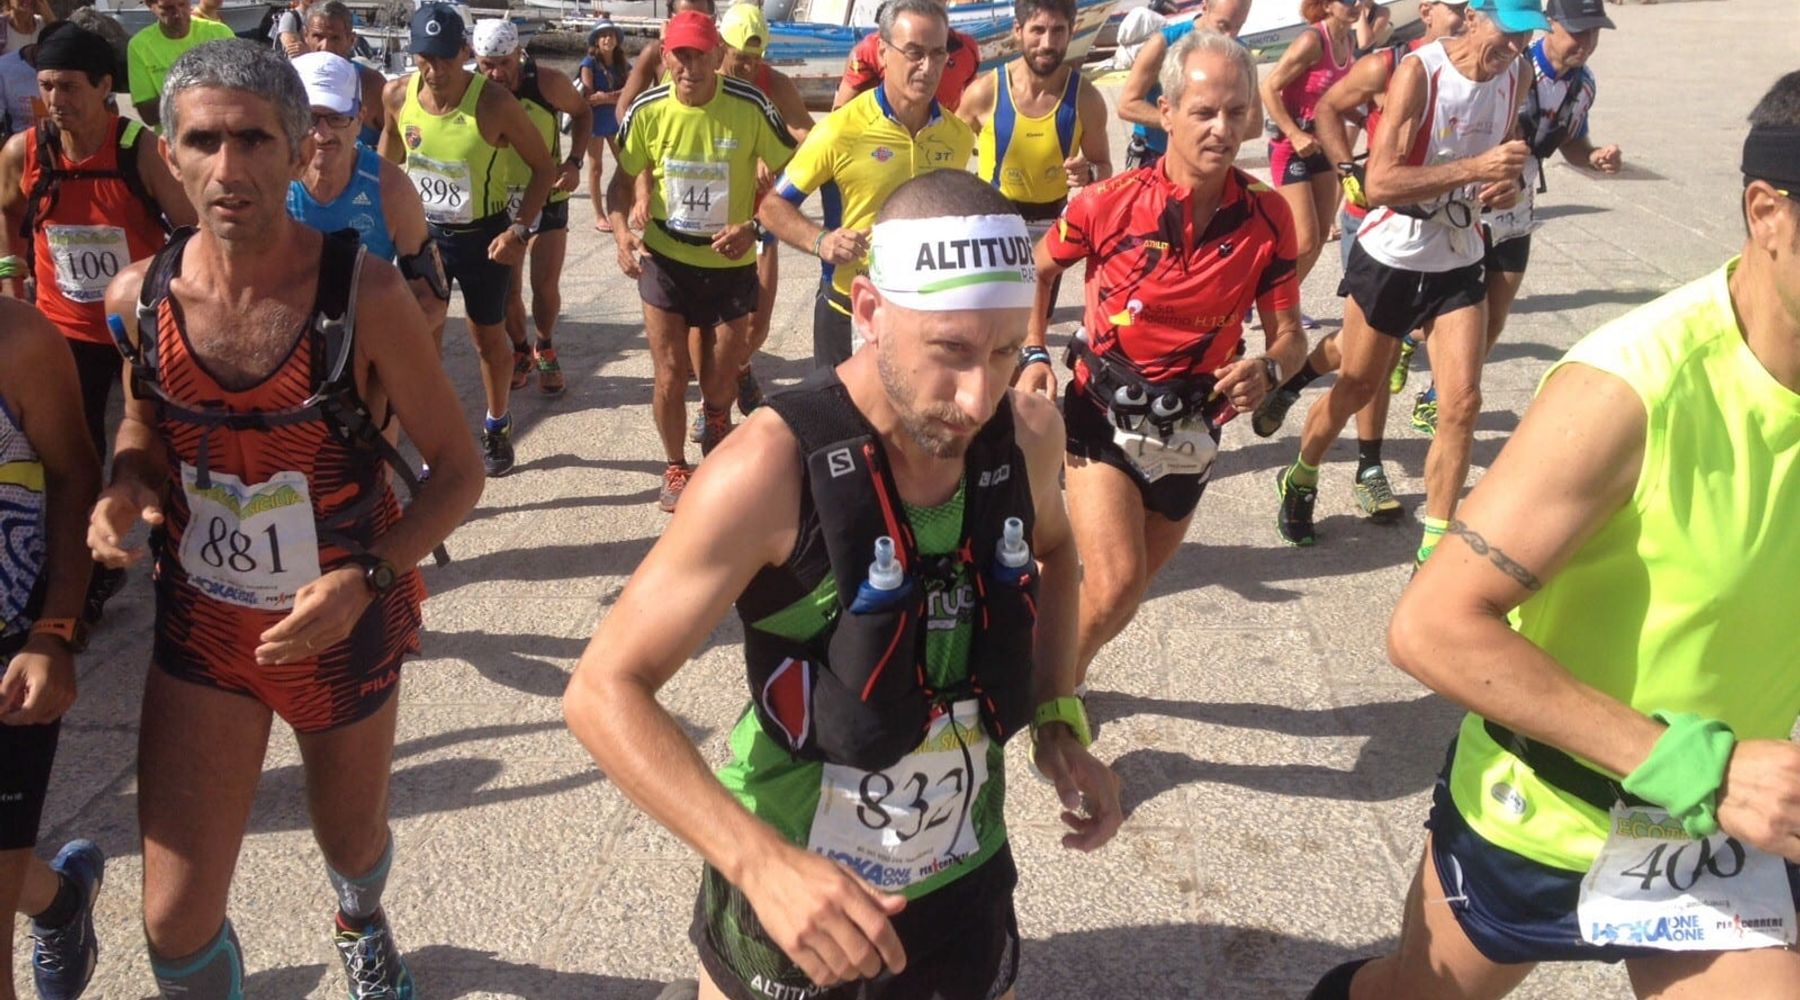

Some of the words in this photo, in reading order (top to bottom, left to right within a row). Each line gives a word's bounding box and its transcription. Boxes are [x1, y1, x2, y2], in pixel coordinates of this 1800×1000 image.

[420, 177, 461, 207] 898
[682, 186, 711, 212] 44
[67, 251, 119, 280] 100
[201, 516, 287, 574] 881
[856, 768, 963, 841] 832
[1667, 915, 1700, 929] ONE
[1674, 928, 1706, 942] ONE
